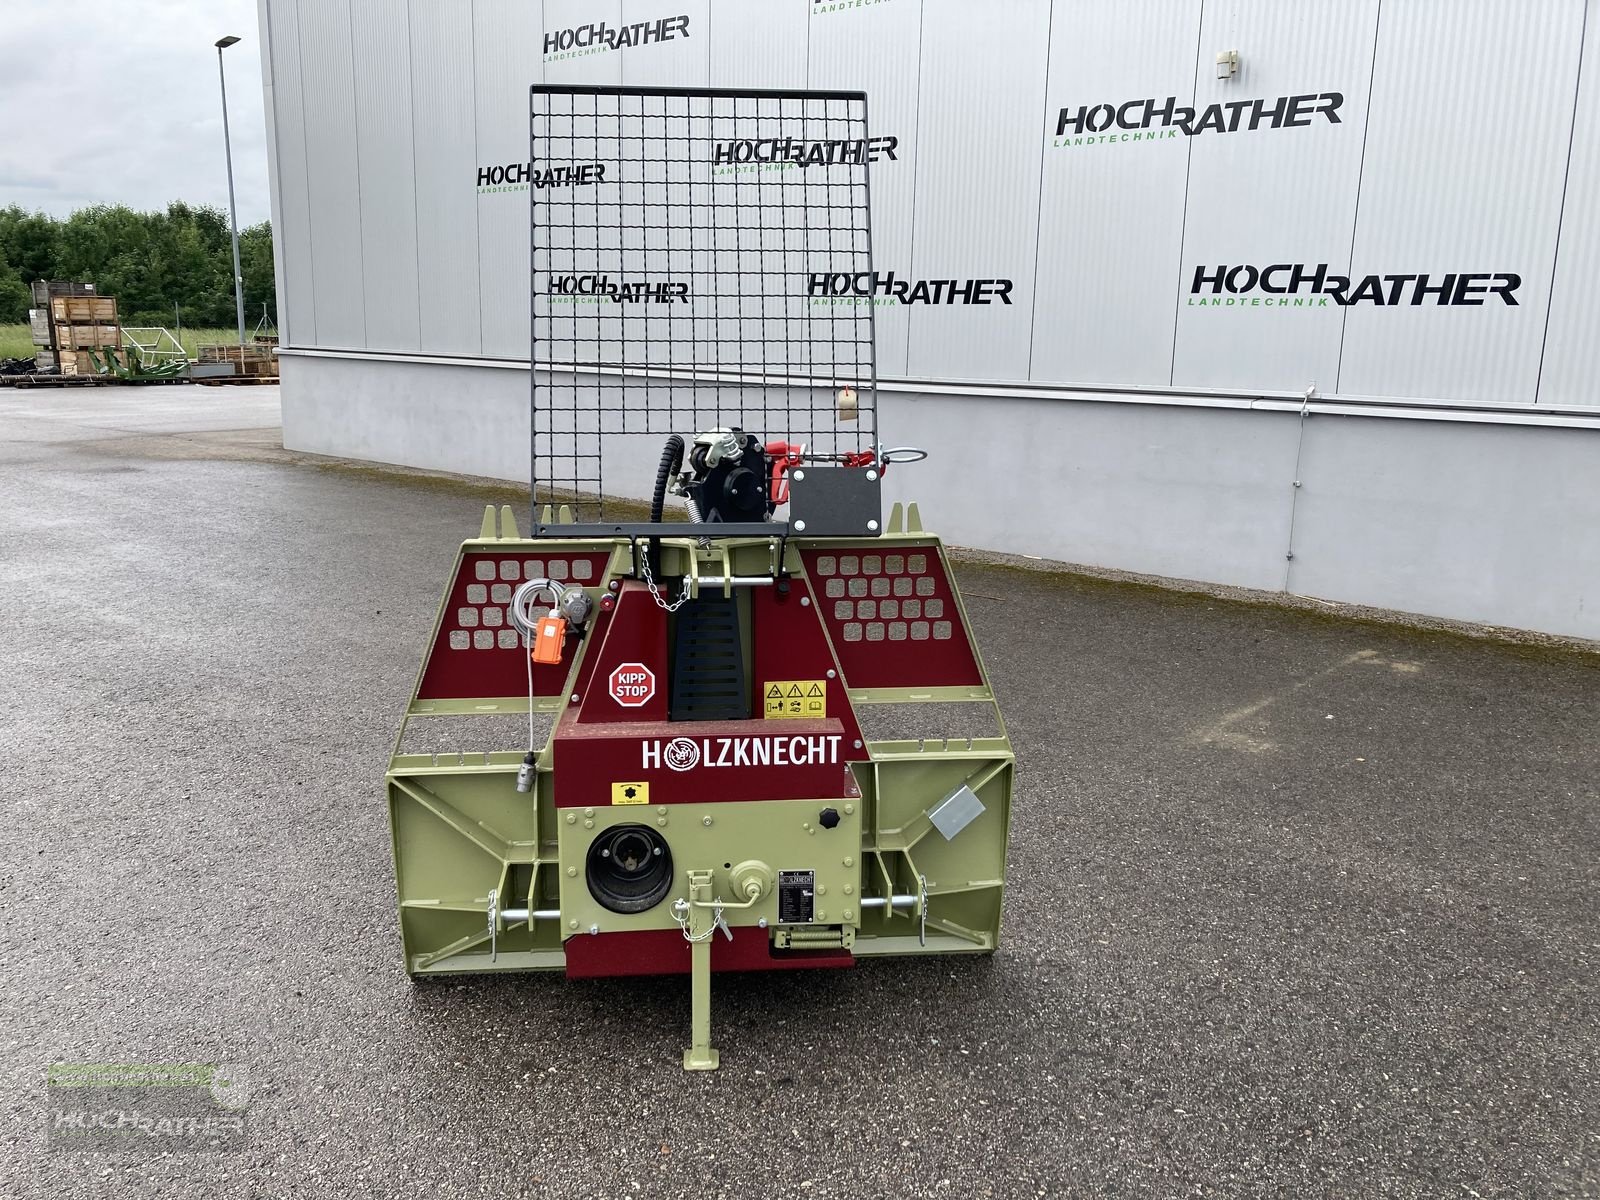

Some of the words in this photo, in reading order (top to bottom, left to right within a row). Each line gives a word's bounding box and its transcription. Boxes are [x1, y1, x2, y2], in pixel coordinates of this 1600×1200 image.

[543, 15, 690, 54] HOCHRATHER
[543, 46, 607, 63] LANDTECHNIK
[1055, 92, 1344, 136] HOCHRATHER
[714, 136, 899, 168] HOCHRATHER
[1053, 129, 1178, 148] LANDTECHNIK
[477, 162, 606, 189] HOCHRATHER
[547, 275, 689, 303] HOCHRATHER
[808, 271, 1014, 305] HOCHRATHER
[1190, 263, 1522, 306] HOCHRATHER
[1187, 297, 1328, 307] LANDTECHNIK
[616, 685, 648, 697] STOP
[618, 672, 647, 684] KIPP
